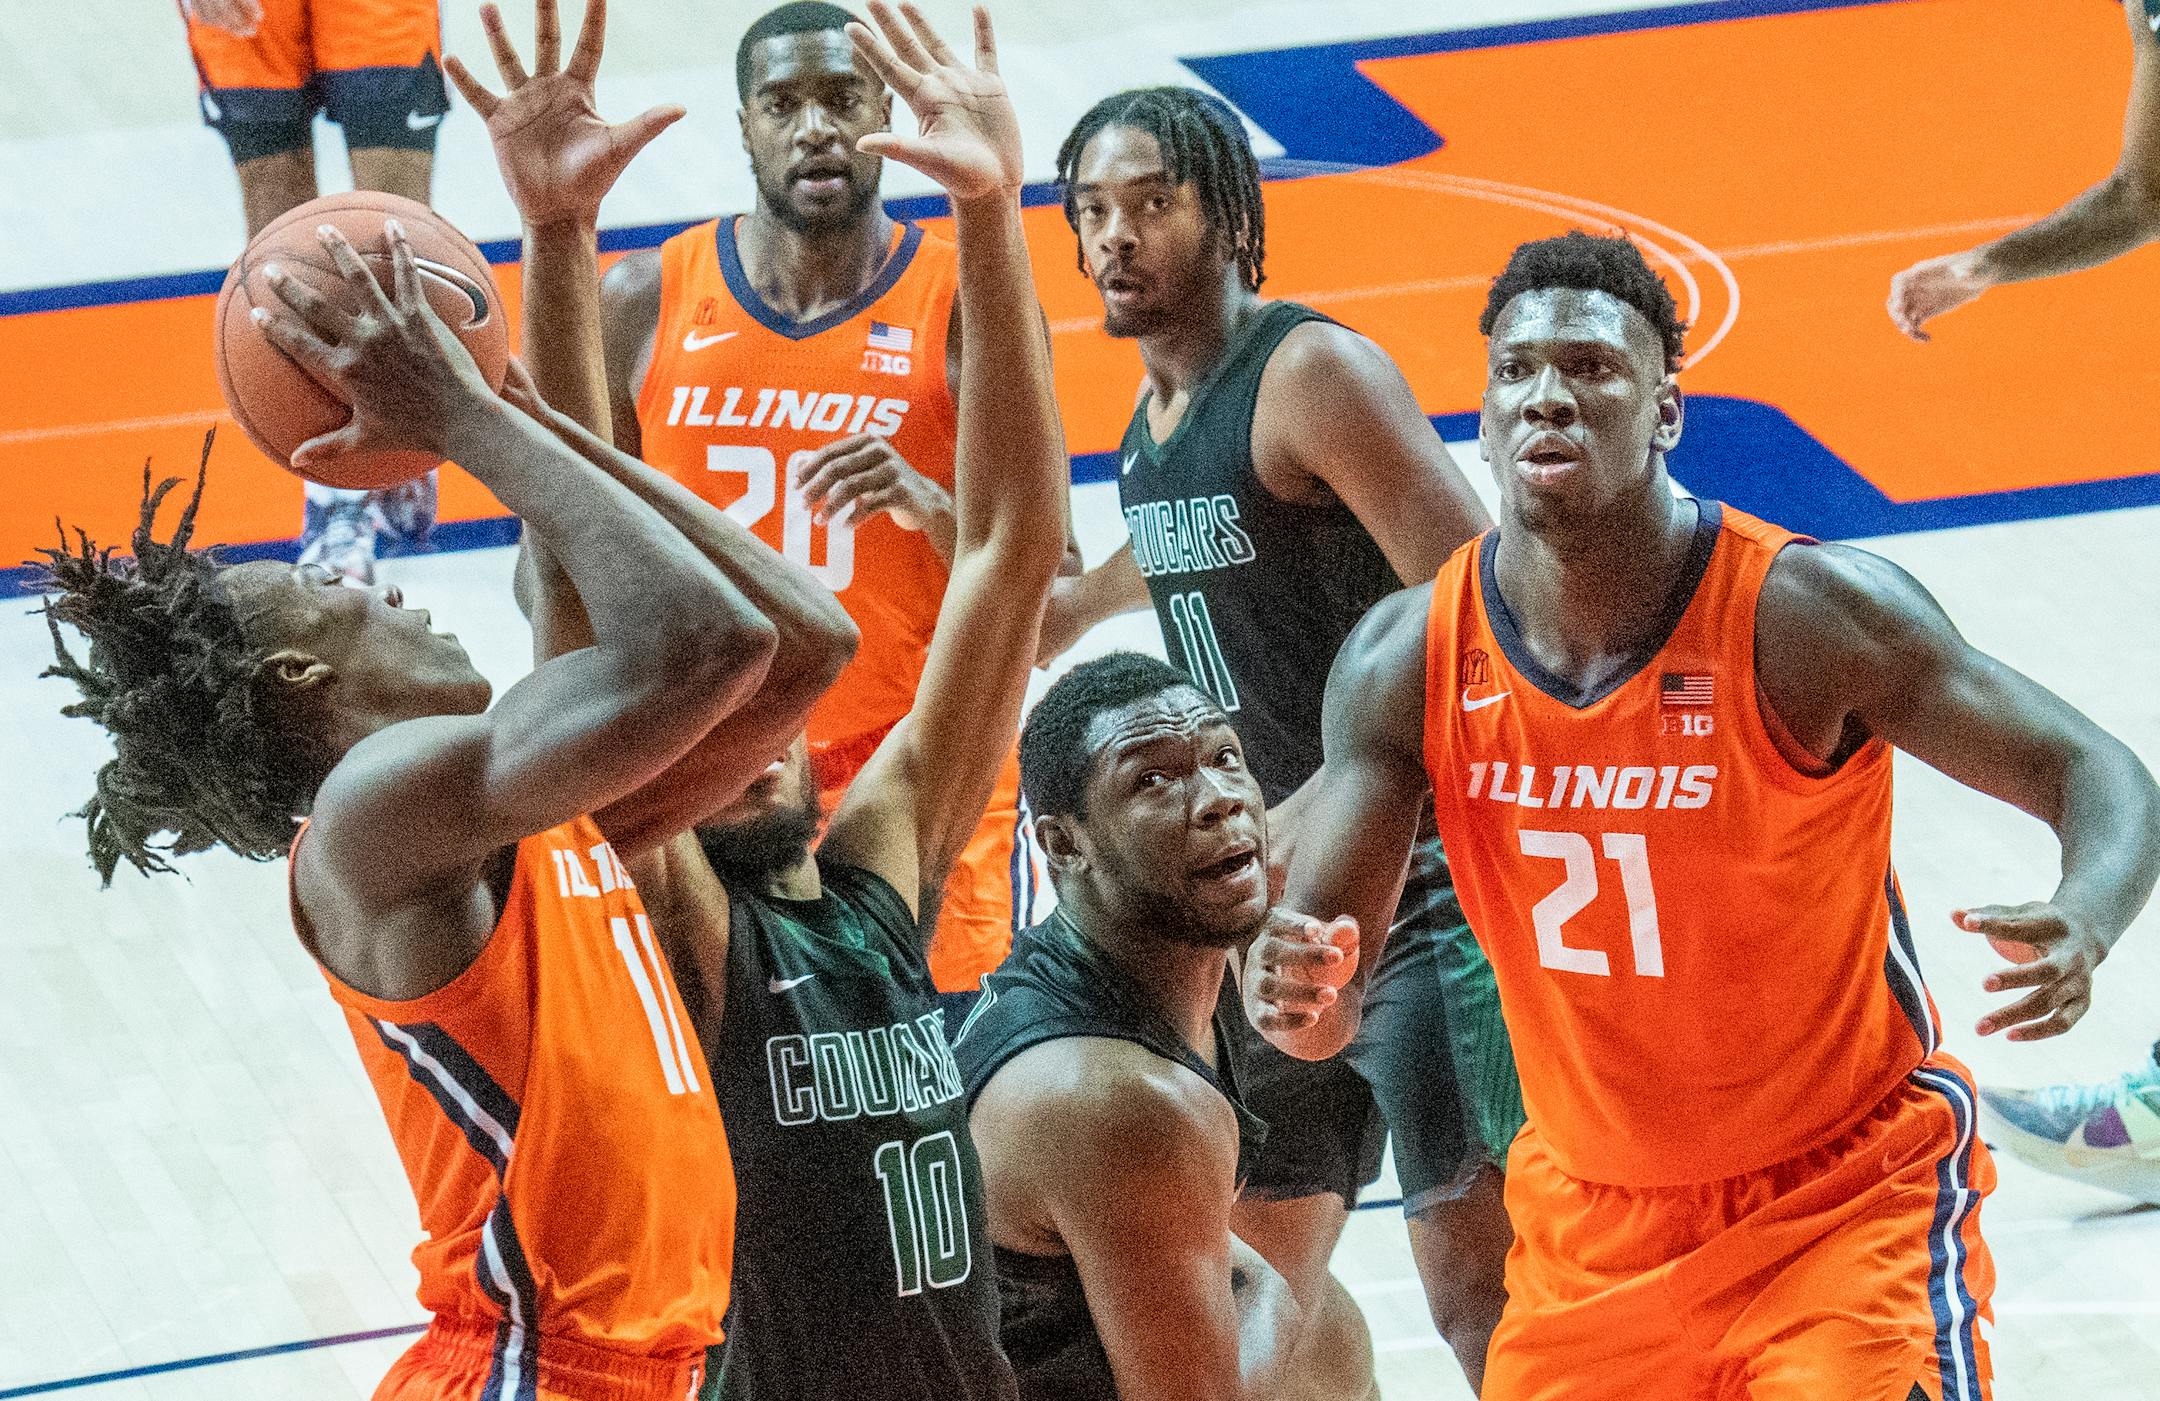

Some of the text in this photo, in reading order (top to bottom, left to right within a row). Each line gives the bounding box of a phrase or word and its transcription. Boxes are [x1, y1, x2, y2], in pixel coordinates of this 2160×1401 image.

[667, 386, 909, 437] ILLINOIS
[707, 445, 855, 592] 20
[1124, 494, 1256, 576] OUGARS
[1169, 591, 1241, 712] 11
[1467, 761, 1718, 810] ILLINOIS
[1518, 829, 1665, 978] 21
[610, 913, 701, 1095] 11
[873, 1130, 972, 1297] 10
